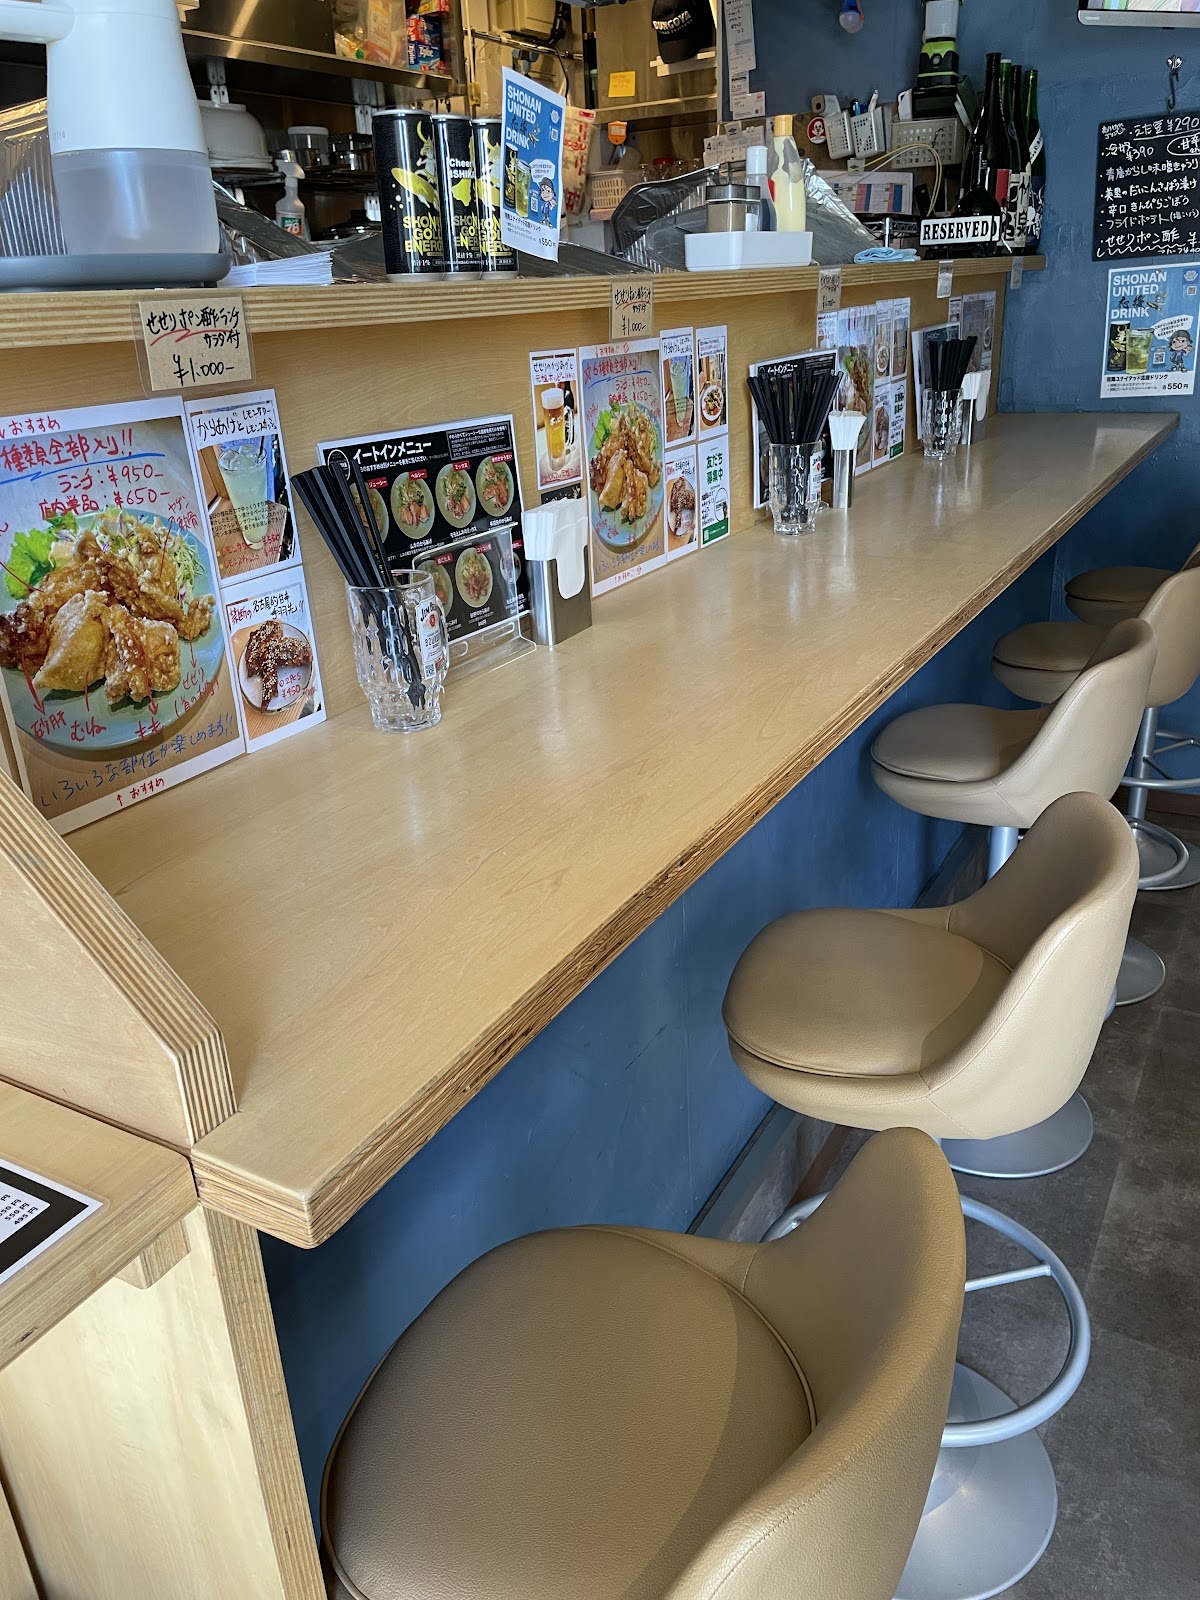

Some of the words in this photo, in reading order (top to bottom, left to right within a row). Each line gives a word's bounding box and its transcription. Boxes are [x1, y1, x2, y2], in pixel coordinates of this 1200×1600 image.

[507, 85, 542, 114] SHONAN
[507, 99, 537, 125] UNITED
[1166, 116, 1200, 132] ¥290
[505, 127, 530, 150] DRINK
[1126, 146, 1154, 162] ¥390
[922, 220, 989, 241] RESERVED
[1113, 271, 1167, 286] SHONAN
[1112, 284, 1159, 298] UNITED
[1111, 307, 1150, 320] DRINK
[203, 328, 241, 349] サラダ付
[353, 441, 432, 465] イートインメニュー
[706, 452, 723, 469] 友だち
[31, 710, 67, 740] 砂肝
[70, 716, 107, 742] むね
[134, 717, 166, 741] もも
[129, 777, 165, 800] おすすめ
